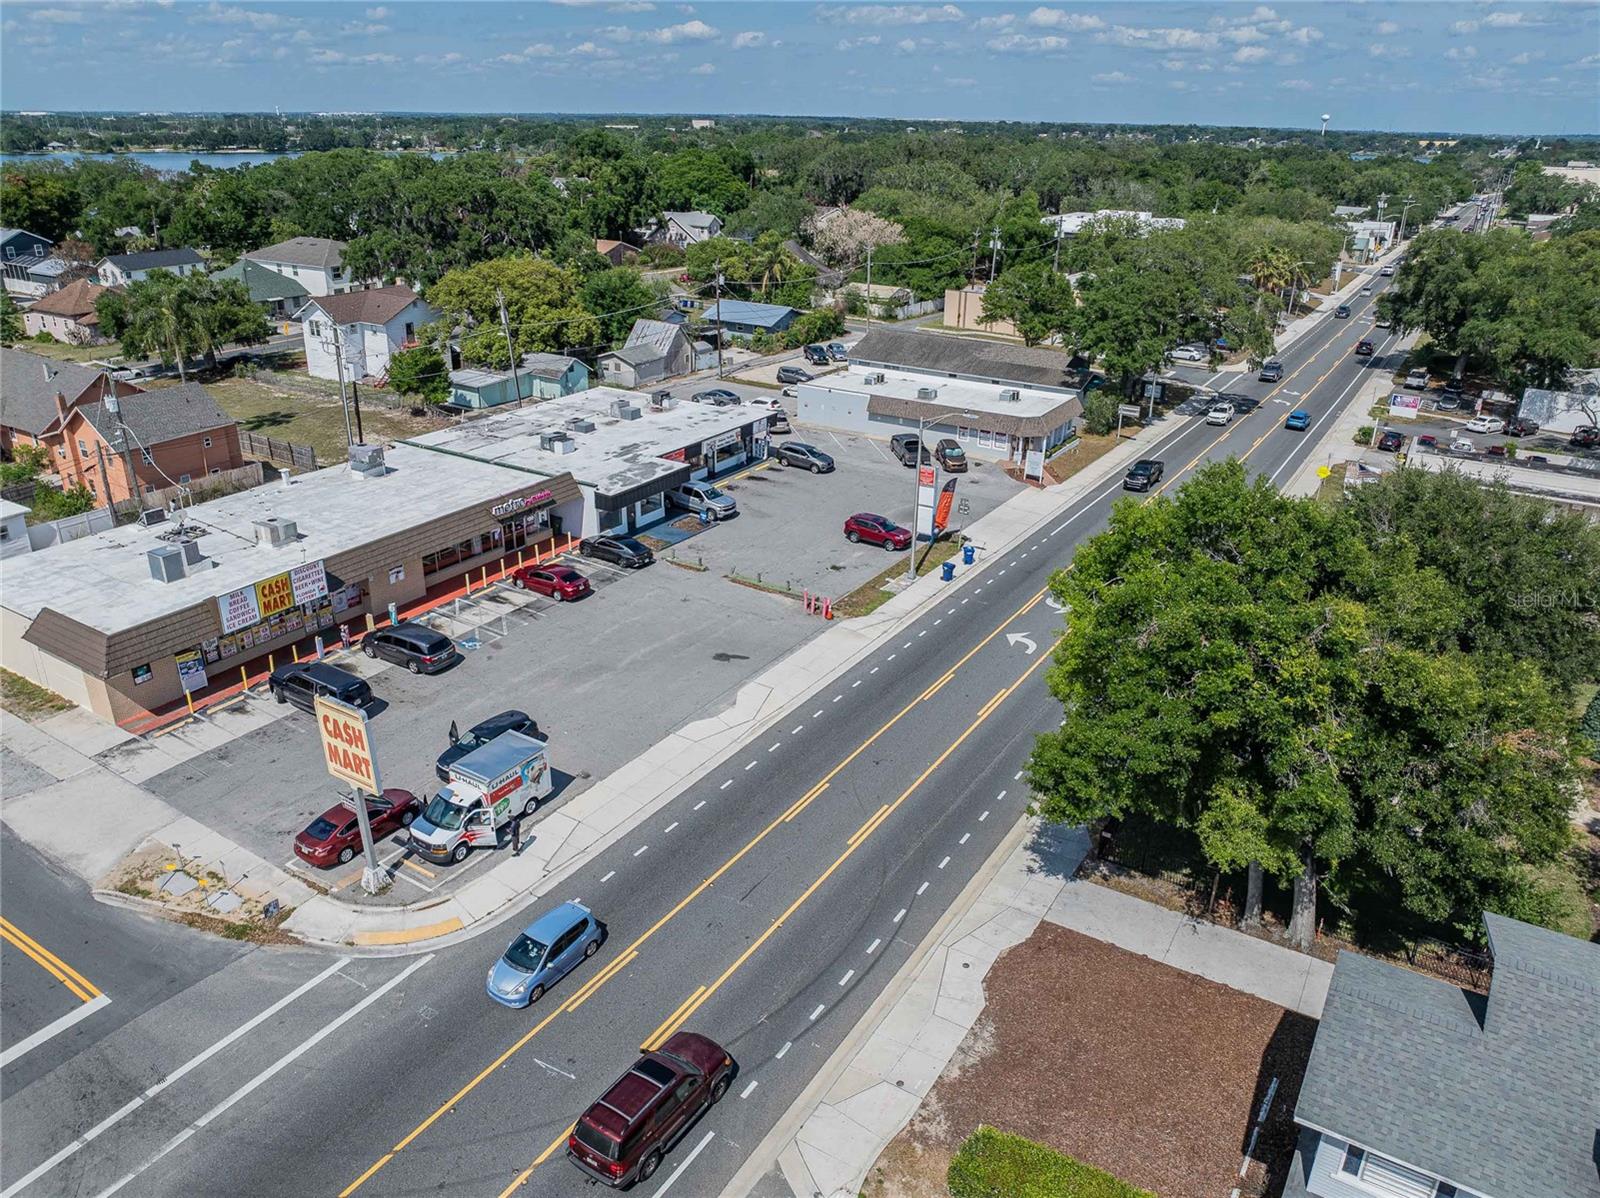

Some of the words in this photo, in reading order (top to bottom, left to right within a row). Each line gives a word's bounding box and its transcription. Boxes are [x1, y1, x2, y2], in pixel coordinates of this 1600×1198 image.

[295, 563, 320, 576] DISCOUNT
[293, 569, 323, 584] CIGARETTES
[229, 591, 244, 600] MILK
[296, 588, 316, 598] FLORIDA
[296, 593, 317, 604] LOTTERY
[228, 597, 248, 607] BREAD
[263, 592, 292, 615] MART
[226, 608, 256, 622] SANDWICH
[229, 603, 250, 615] COFFEE
[227, 622, 236, 630] ICE
[238, 614, 258, 626] CREAM
[327, 742, 372, 780] MART
